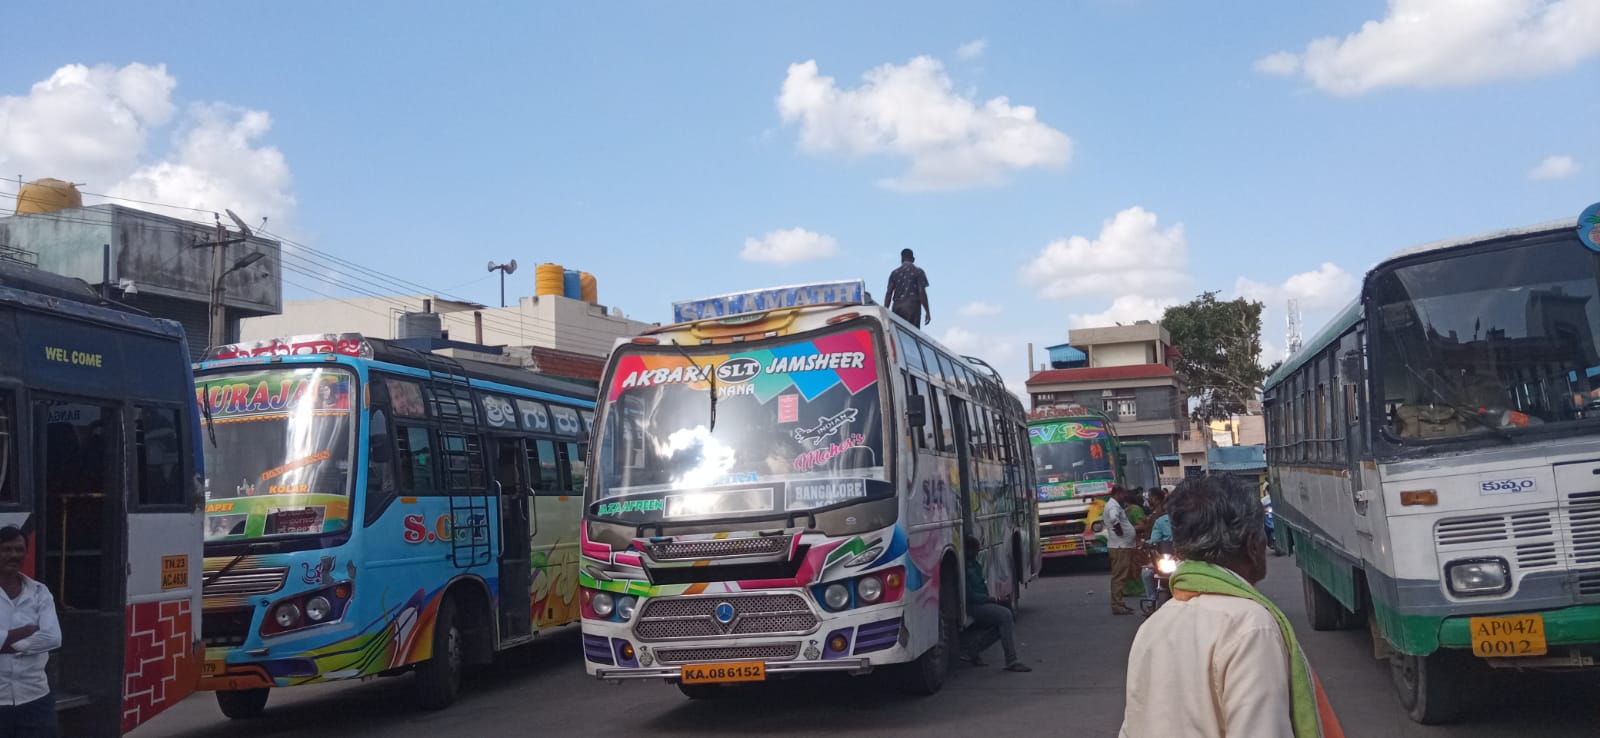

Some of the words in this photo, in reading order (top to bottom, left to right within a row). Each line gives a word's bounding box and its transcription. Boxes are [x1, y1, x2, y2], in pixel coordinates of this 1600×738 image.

[680, 284, 856, 321] SALAMATH
[622, 364, 713, 388] AKBARI
[719, 362, 759, 379] SLT
[765, 352, 865, 374] JAMSHEER
[718, 384, 755, 396] NANA
[817, 413, 847, 435] INDIAN
[268, 484, 309, 495] KOLAR
[795, 482, 863, 500] BANGALORE
[1481, 479, 1534, 493] కుప్పం
[1477, 619, 1537, 635] AP04Z
